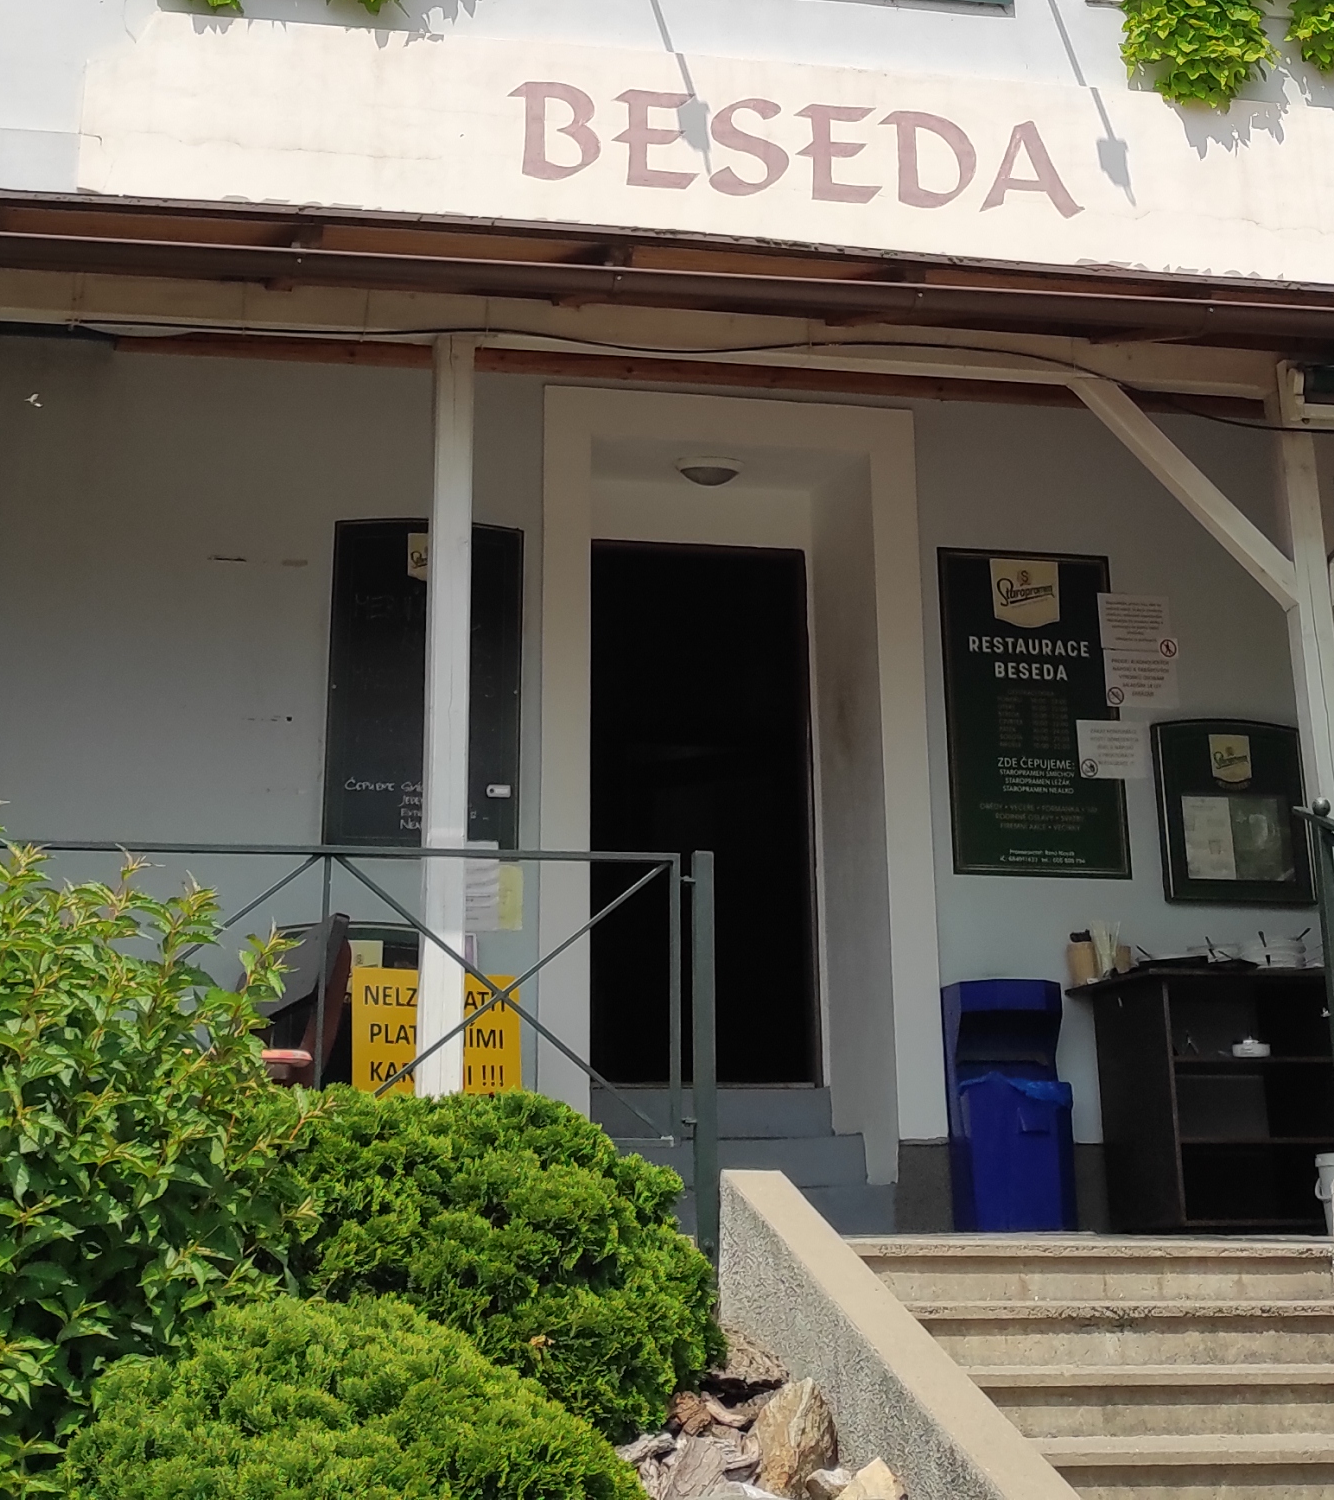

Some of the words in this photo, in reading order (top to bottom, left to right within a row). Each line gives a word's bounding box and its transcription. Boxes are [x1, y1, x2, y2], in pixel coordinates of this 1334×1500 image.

[507, 80, 1086, 220] BESEDA
[968, 636, 1090, 658] RESTAURACE
[994, 661, 1069, 682] BESEDA
[997, 757, 1018, 768] ZDE
[1019, 755, 1075, 771] ČEPUJEME:
[363, 985, 418, 1008] NELZ
